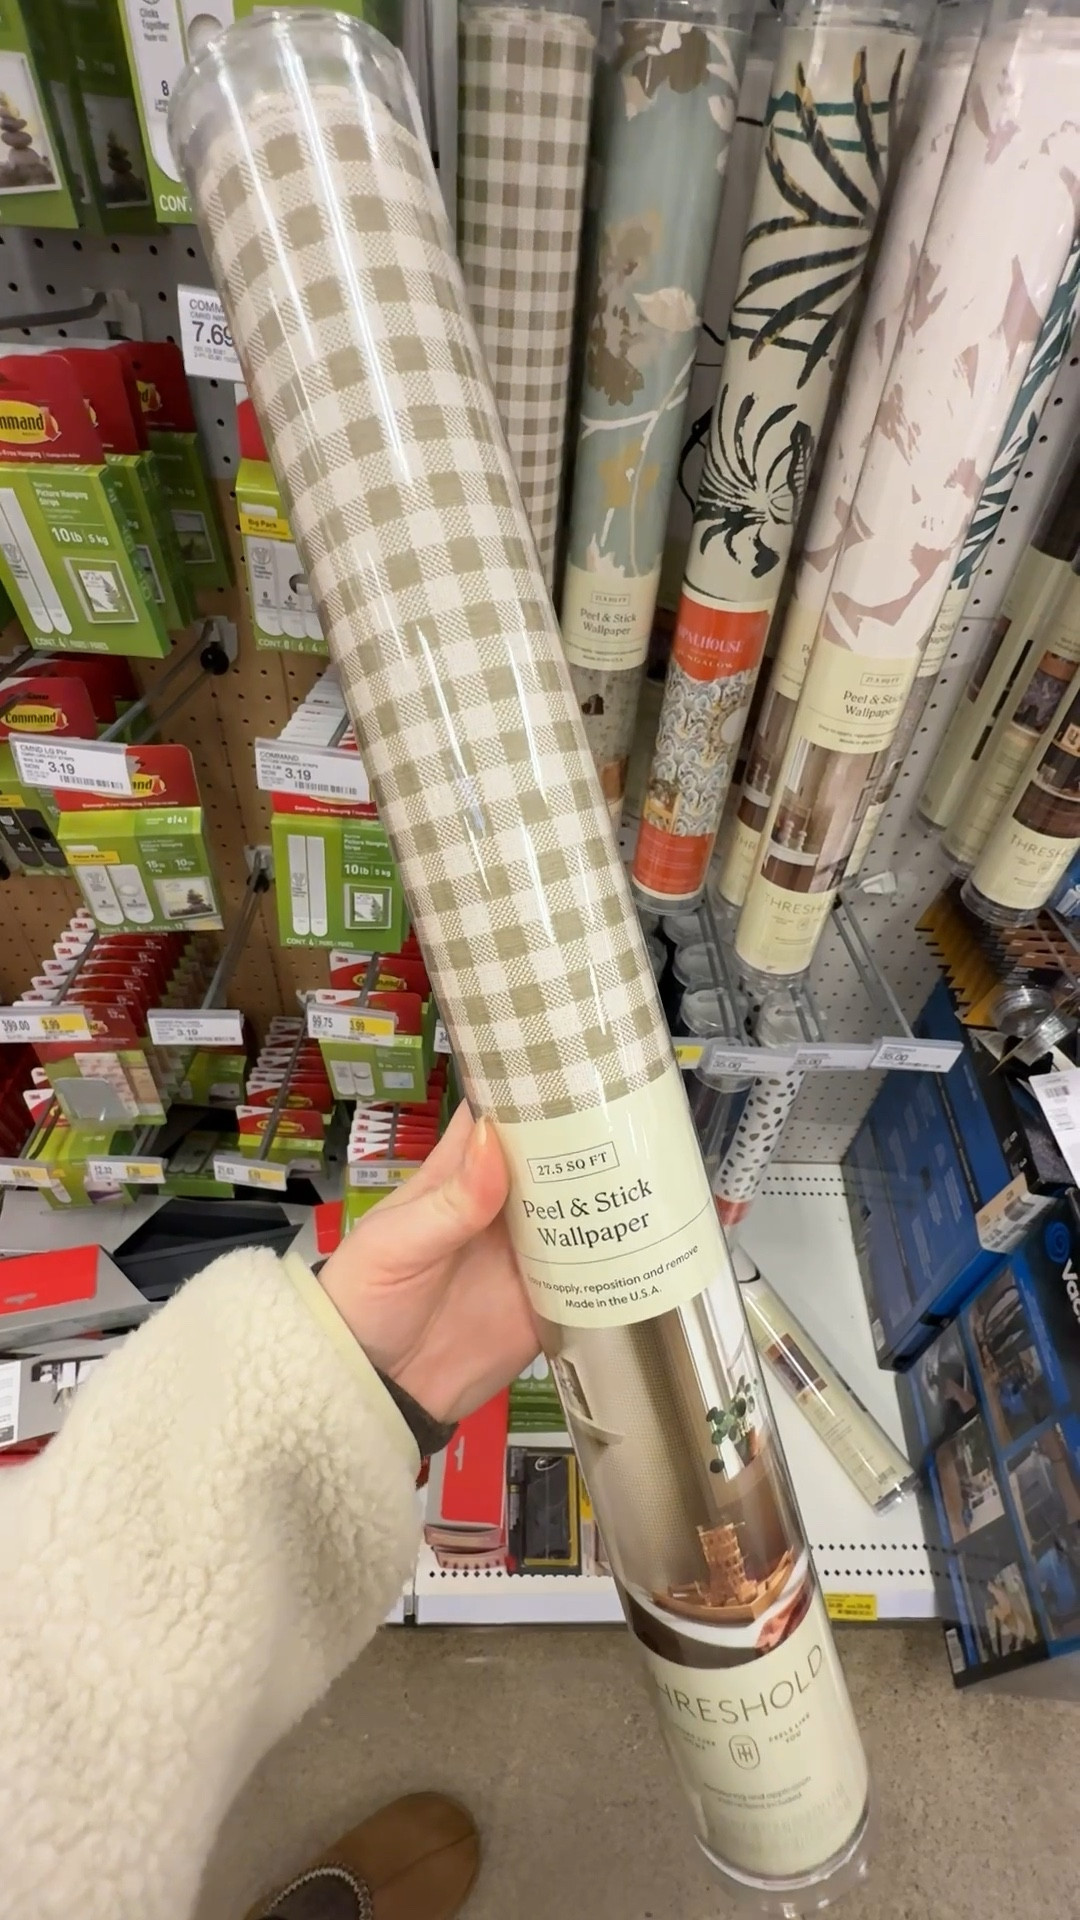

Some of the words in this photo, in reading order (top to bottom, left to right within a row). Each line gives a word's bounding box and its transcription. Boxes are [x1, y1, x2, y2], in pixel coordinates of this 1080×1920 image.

[161, 80, 169, 96] 8
[189, 299, 225, 312] COMM
[192, 320, 236, 347] 7.69
[0, 414, 44, 431] mmand
[260, 520, 277, 529] Pack
[97, 535, 109, 546] kg
[580, 607, 600, 620] Peel
[601, 613, 611, 622] &
[613, 613, 636, 623] Stick
[583, 621, 631, 636] Wallpaper
[679, 624, 745, 653] PALHOUSE
[843, 690, 867, 704] Peel
[869, 695, 881, 704] &
[5, 713, 56, 724] Command
[260, 751, 299, 761] COMMAND
[48, 761, 75, 775] 3.19
[285, 767, 312, 781] 3.19
[1011, 834, 1068, 859] THRESH
[765, 893, 826, 915] THRESH
[42, 1019, 60, 1030] 3.99
[313, 1015, 333, 1028] 99.75
[350, 1020, 365, 1032] 3.99
[537, 1163, 563, 1176] 27.5
[567, 1159, 585, 1172] SQ
[589, 1152, 607, 1166] FT
[523, 1200, 565, 1220] Peel
[570, 1197, 590, 1218] &
[595, 1178, 652, 1212] Stick
[537, 1213, 649, 1248] Wallpaper
[542, 1281, 552, 1290] to
[553, 1283, 582, 1295] apply,
[584, 1276, 641, 1294] reposition
[643, 1264, 664, 1280] and
[666, 1245, 698, 1270] remove
[565, 1299, 594, 1308] Made
[596, 1298, 607, 1308] in
[609, 1296, 628, 1307] the
[630, 1286, 662, 1301] U.S.A.
[656, 1644, 823, 1724] HRESHOLD
